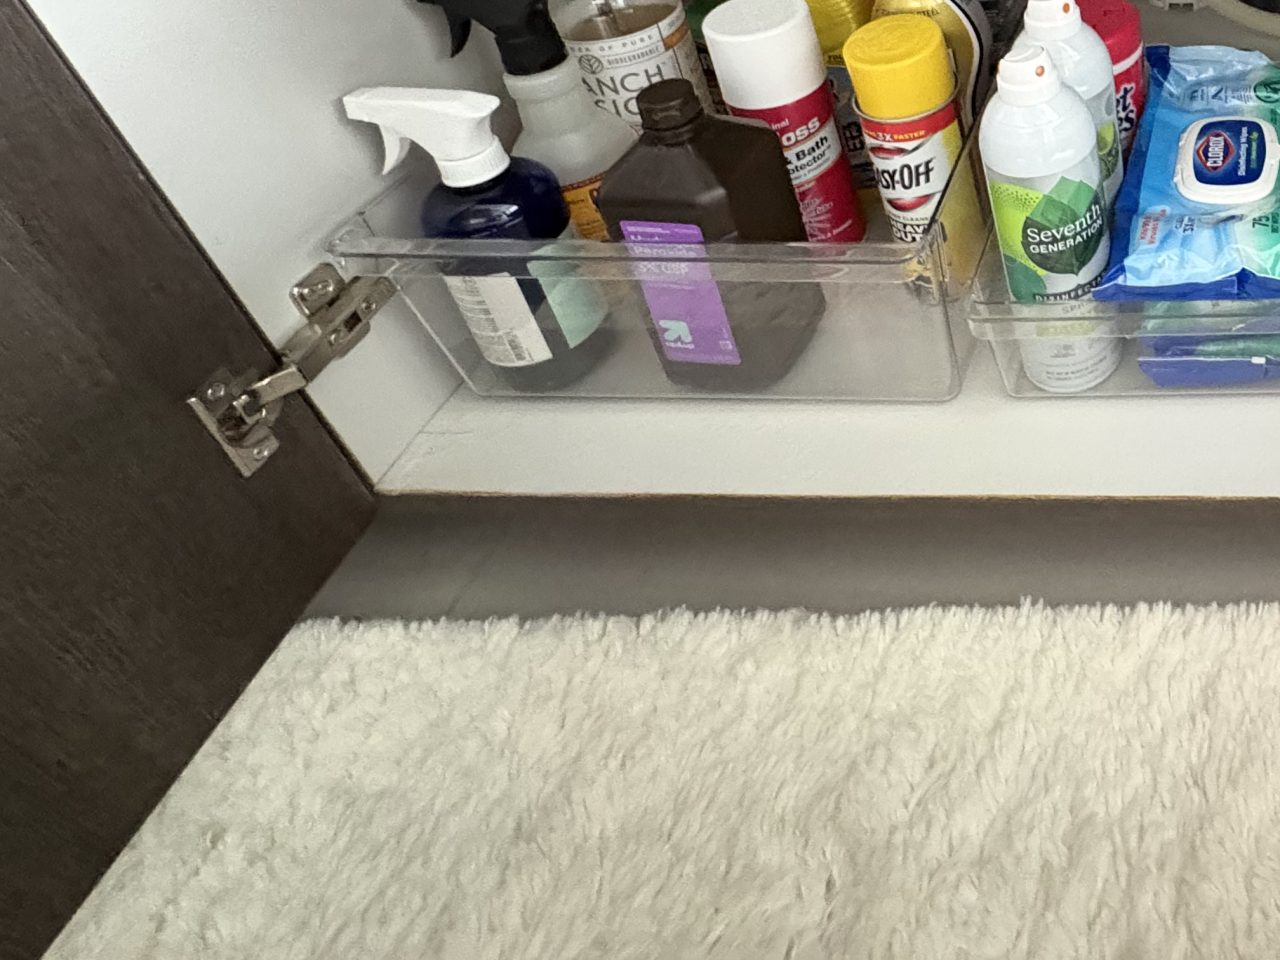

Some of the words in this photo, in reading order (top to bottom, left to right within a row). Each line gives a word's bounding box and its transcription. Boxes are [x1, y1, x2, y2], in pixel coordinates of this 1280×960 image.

[581, 64, 666, 98] ANCH
[771, 118, 790, 131] inal
[877, 132, 893, 142] 3X
[893, 130, 927, 141] FASTER
[795, 135, 830, 163] Bath
[1207, 136, 1225, 167] CLOROX
[789, 150, 830, 176] otector
[890, 218, 929, 234] HEAV
[1026, 204, 1101, 242] Seventh
[1252, 215, 1270, 228] 75
[893, 227, 925, 243] DUT
[1029, 216, 1103, 254] GENERATION
